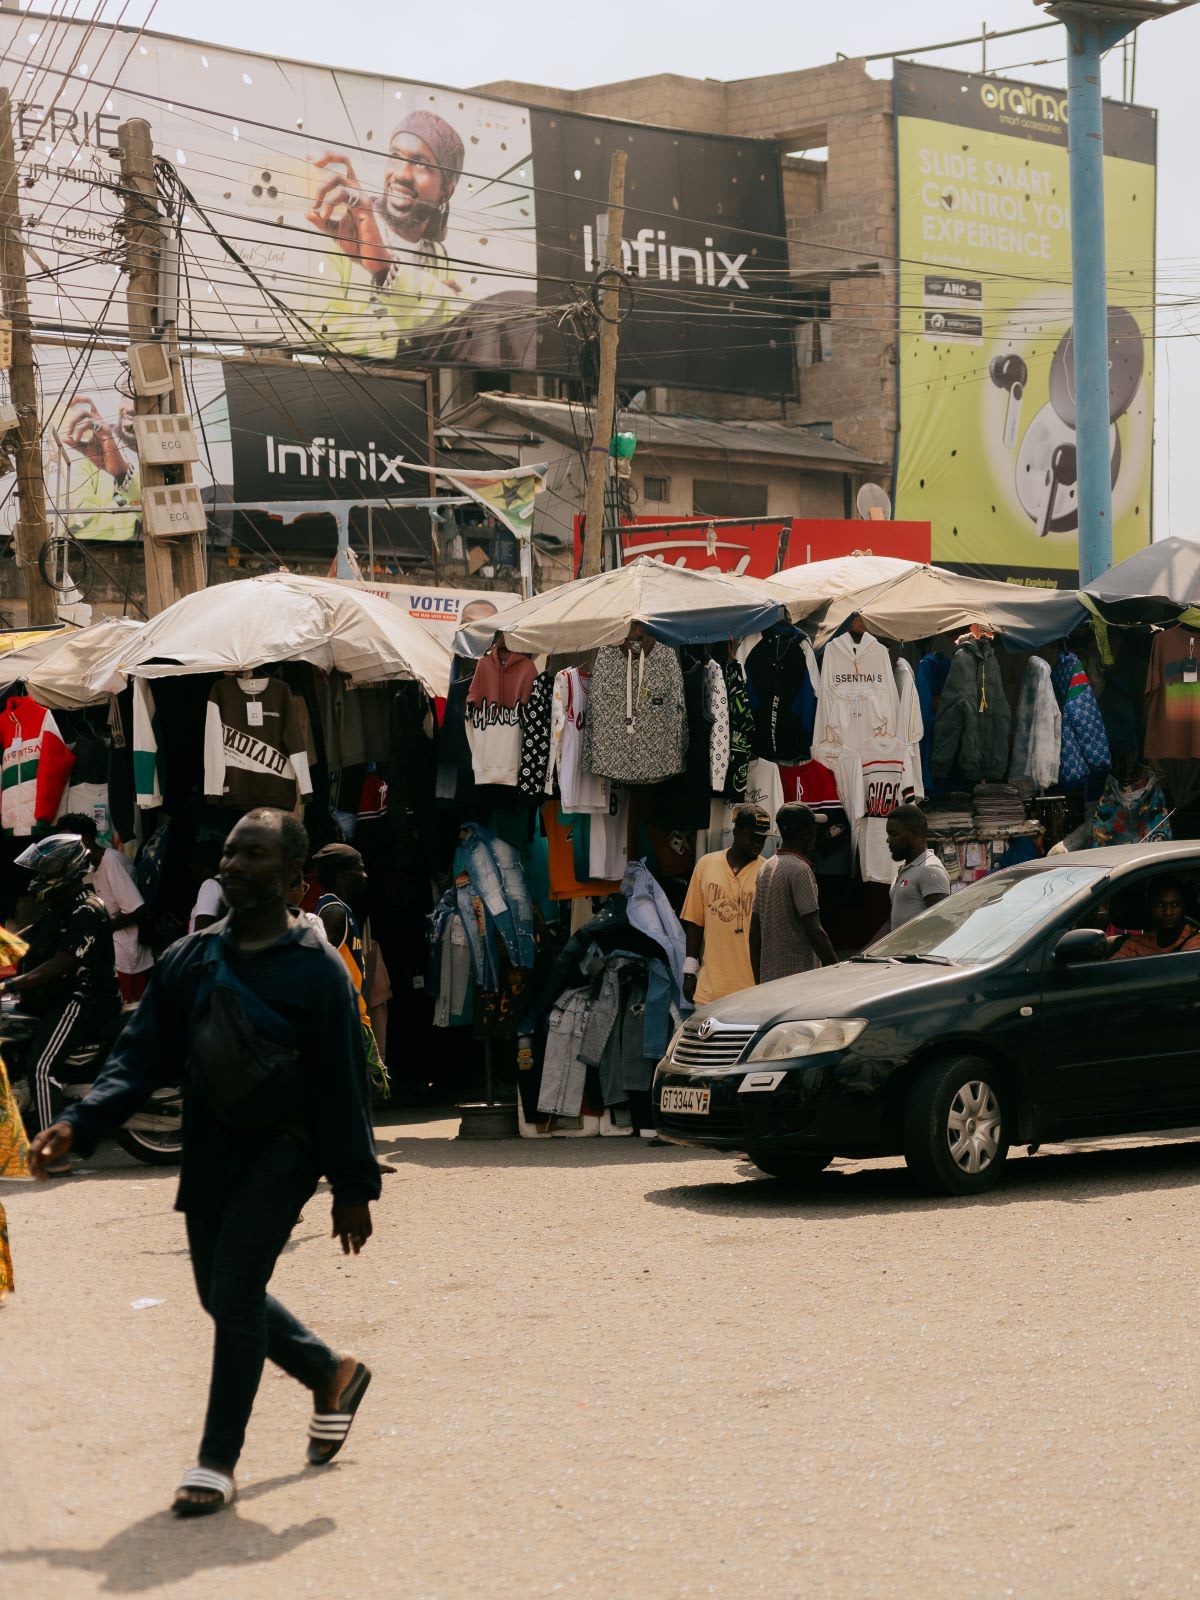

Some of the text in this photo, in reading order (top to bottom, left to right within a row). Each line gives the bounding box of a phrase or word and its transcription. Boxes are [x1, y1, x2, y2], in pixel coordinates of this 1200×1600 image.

[919, 148, 977, 182] SLIDE
[921, 181, 1028, 225] CONTROL
[922, 214, 1052, 260] EXPERIENCE
[943, 282, 967, 296] ANC
[161, 440, 182, 450] ECG
[266, 435, 405, 484] Infinix
[169, 512, 190, 522] ECG
[409, 595, 460, 613] VOTE!
